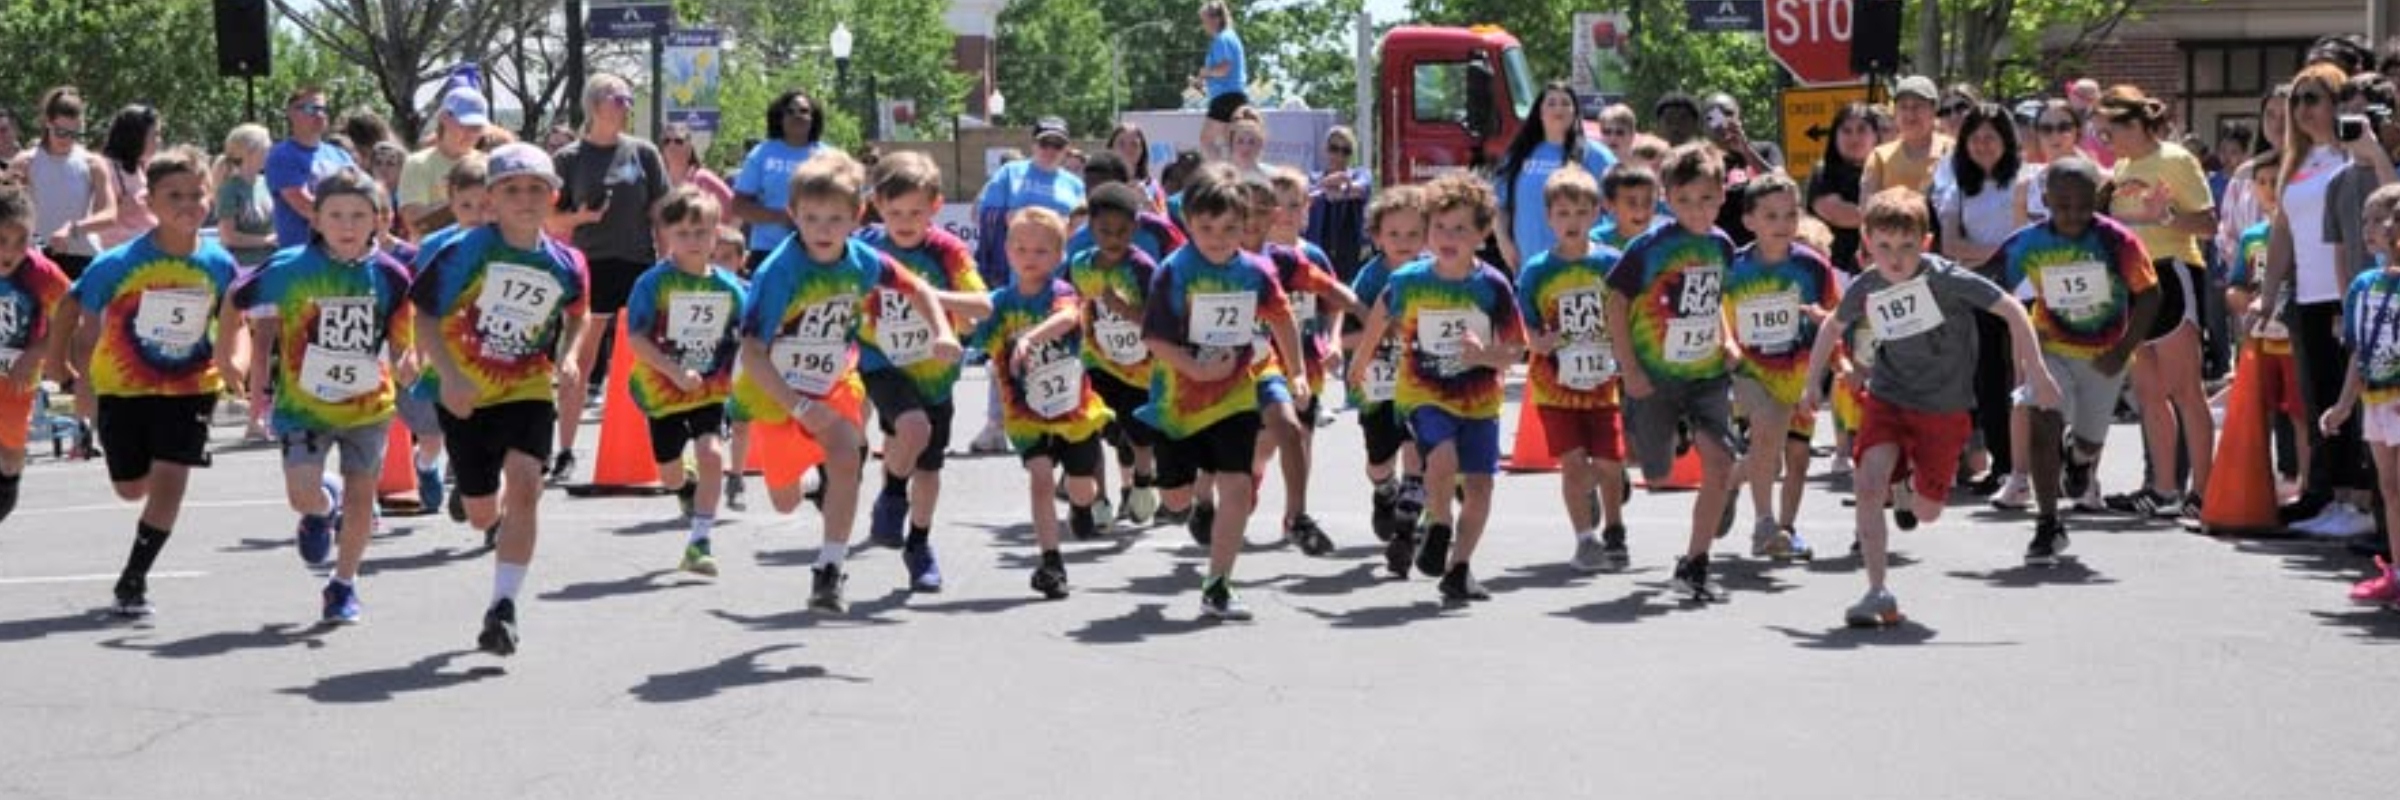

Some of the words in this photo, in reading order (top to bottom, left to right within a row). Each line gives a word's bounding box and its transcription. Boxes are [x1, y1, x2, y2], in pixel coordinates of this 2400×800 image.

[1775, 0, 1852, 44] STO
[502, 279, 547, 305] 175
[2062, 276, 2088, 294] 15
[171, 307, 185, 324] 5
[320, 303, 374, 330] FUN
[691, 304, 714, 323] 75
[1215, 306, 1239, 326] 72
[1877, 294, 1916, 321] 187
[1752, 310, 1789, 327] 180
[890, 329, 928, 348] 179
[1106, 331, 1138, 349] 190
[791, 353, 834, 373] 196
[326, 365, 357, 384] 45
[1039, 375, 1067, 398] 32
